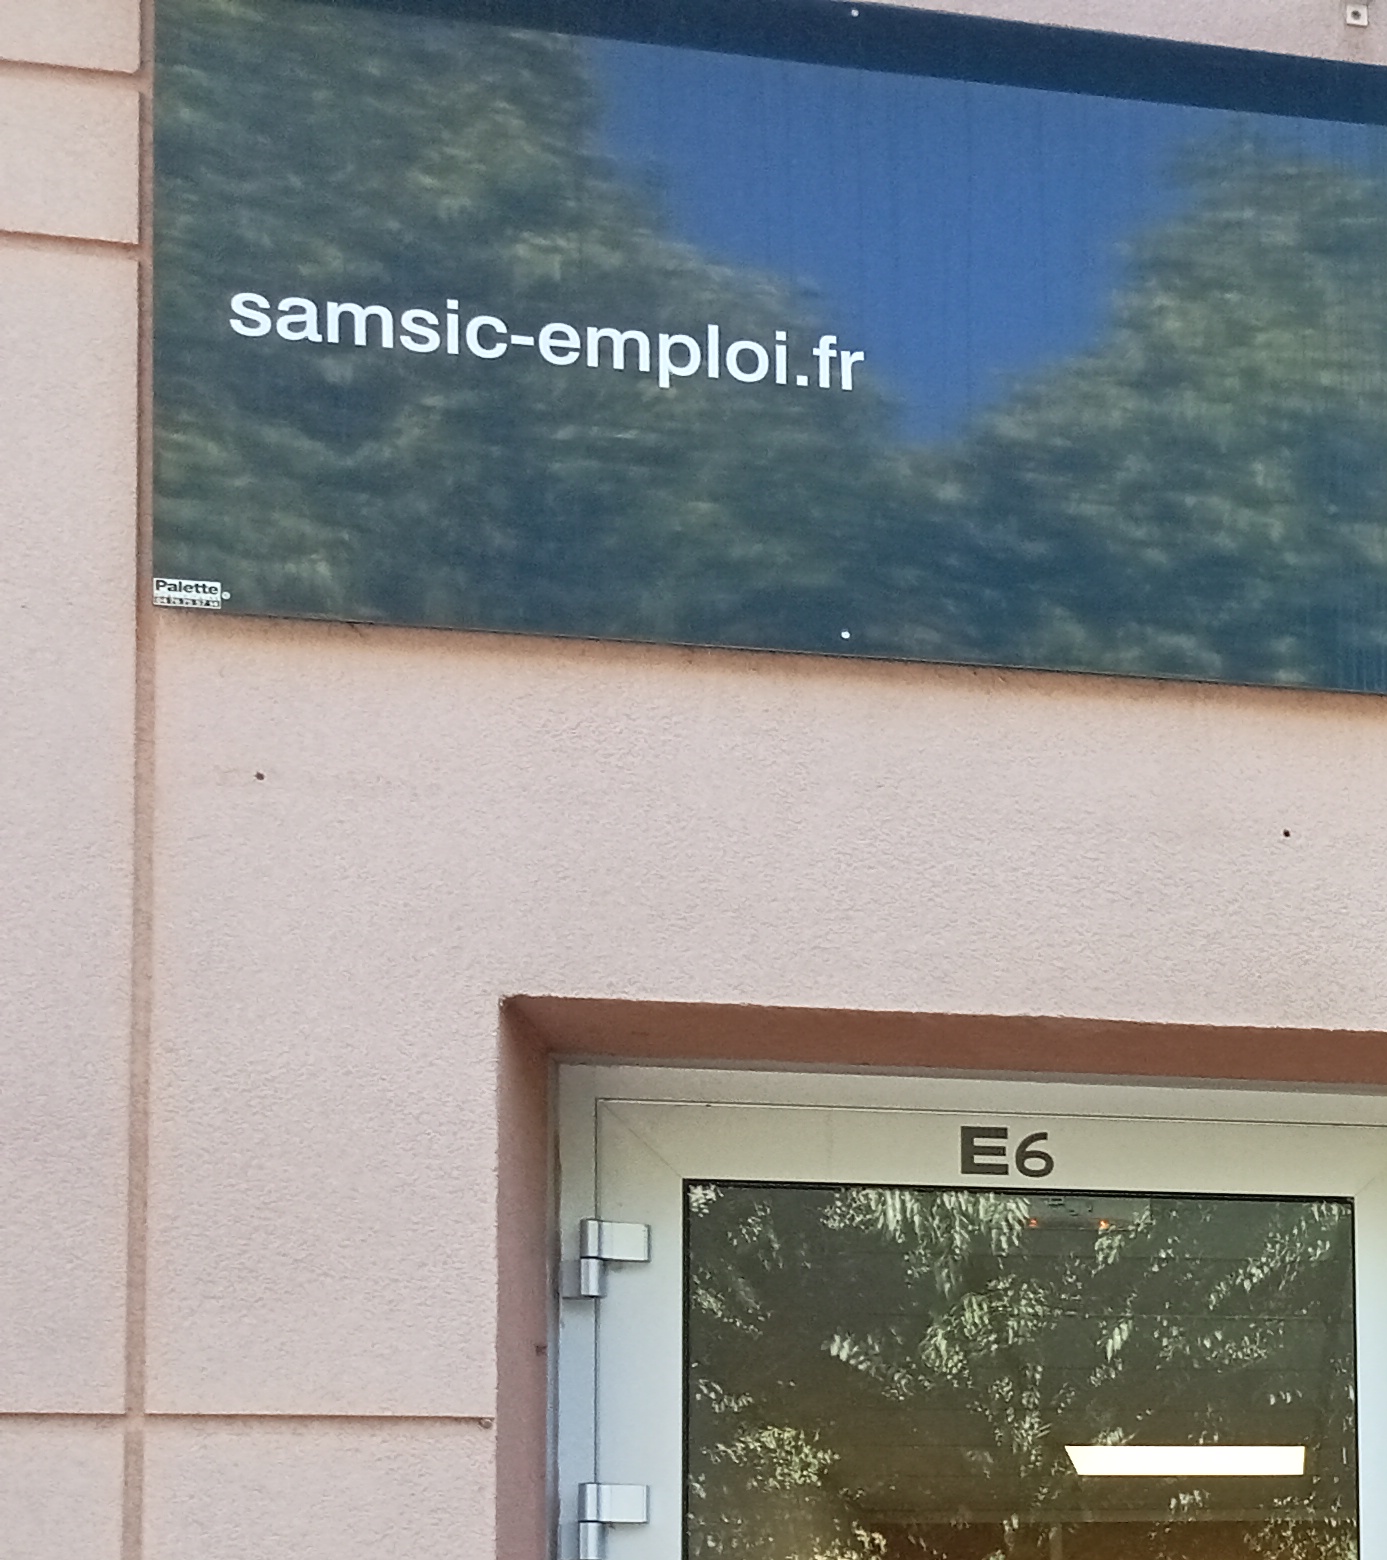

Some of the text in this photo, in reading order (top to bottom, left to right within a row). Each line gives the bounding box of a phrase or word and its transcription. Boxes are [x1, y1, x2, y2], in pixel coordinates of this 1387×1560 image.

[229, 289, 866, 392] samsic-emploi.fr
[155, 579, 219, 595] Palette
[960, 1125, 1055, 1178] E6
